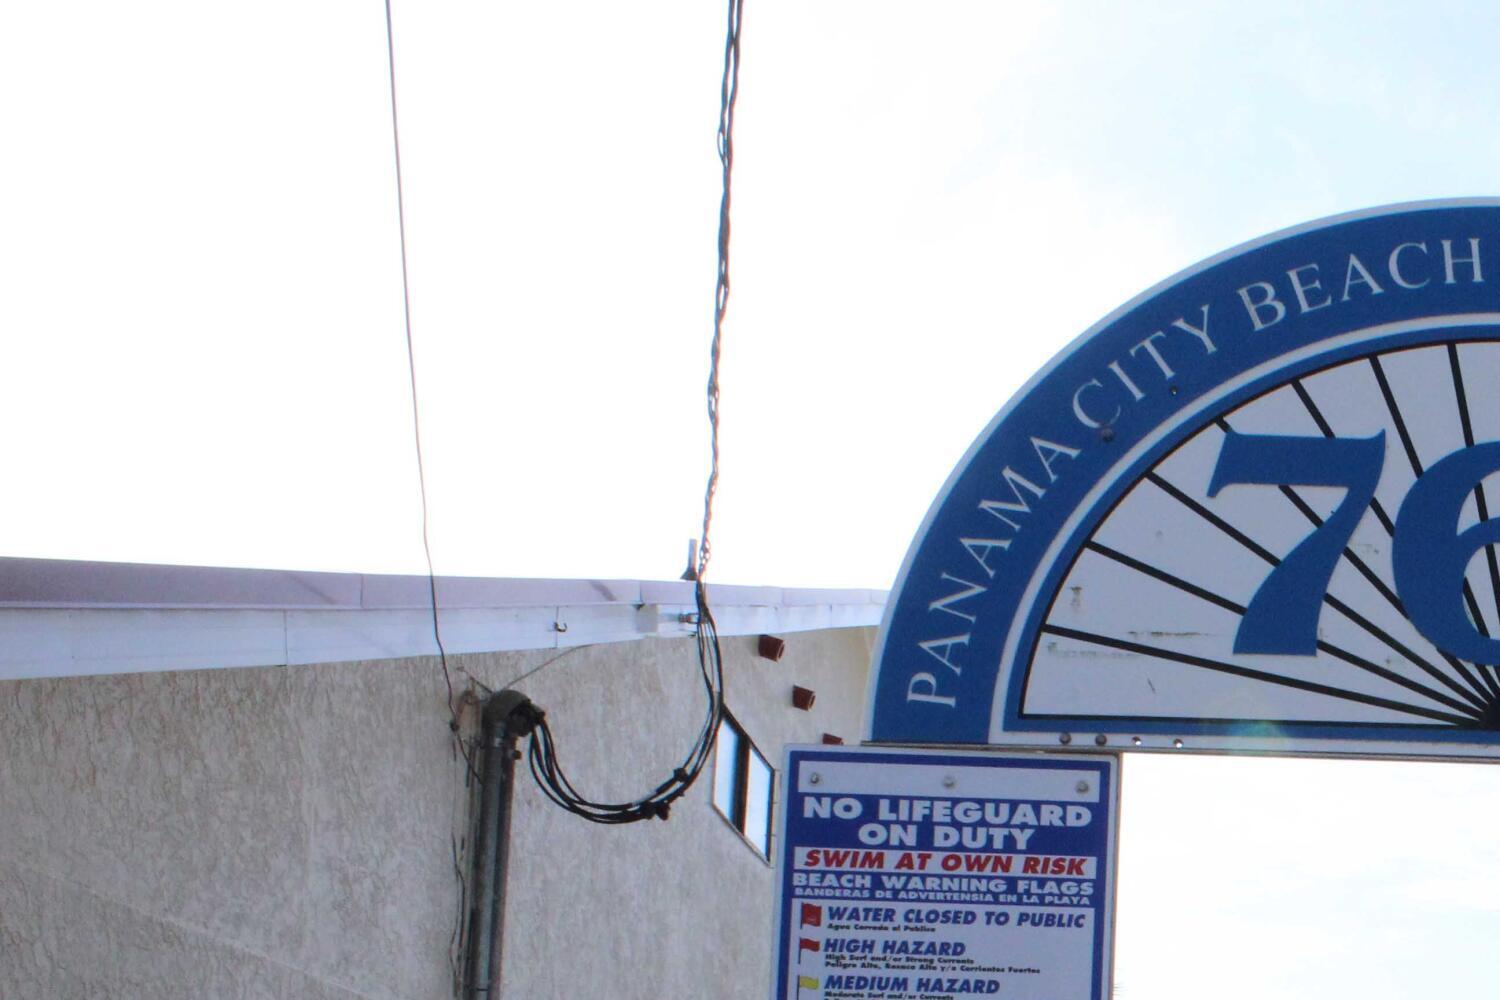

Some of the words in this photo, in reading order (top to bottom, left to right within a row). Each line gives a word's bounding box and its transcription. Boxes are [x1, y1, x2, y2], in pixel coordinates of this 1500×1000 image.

[907, 433, 1082, 708] PANAMA
[1072, 304, 1218, 429] CITY
[1236, 238, 1485, 332] BEACH
[803, 797, 862, 819] NO
[879, 799, 1091, 826] LIFEGUARD
[859, 824, 917, 846] ON
[934, 826, 1036, 849] DUTY
[804, 850, 884, 869] SWIM
[895, 853, 932, 870] AT
[941, 854, 1012, 872] OWN
[1022, 856, 1087, 875] RISK
[793, 872, 871, 888] BEACH
[880, 875, 1007, 893] WARNING
[1017, 879, 1093, 895] FLAGS
[795, 887, 869, 898] BANDERAS
[876, 889, 893, 898] DE
[1000, 894, 1016, 902] EN
[1022, 894, 1039, 903] LA
[1045, 895, 1090, 905] PLAYA
[828, 906, 895, 922] WATER
[904, 909, 976, 925] CLOSED
[985, 912, 1009, 926] TO
[1017, 913, 1086, 928] PUBLIC
[824, 938, 875, 954] HIGH
[883, 940, 966, 955] HAZARD
[824, 975, 908, 991] MEDIUM
[916, 978, 1000, 994] HAZARD
